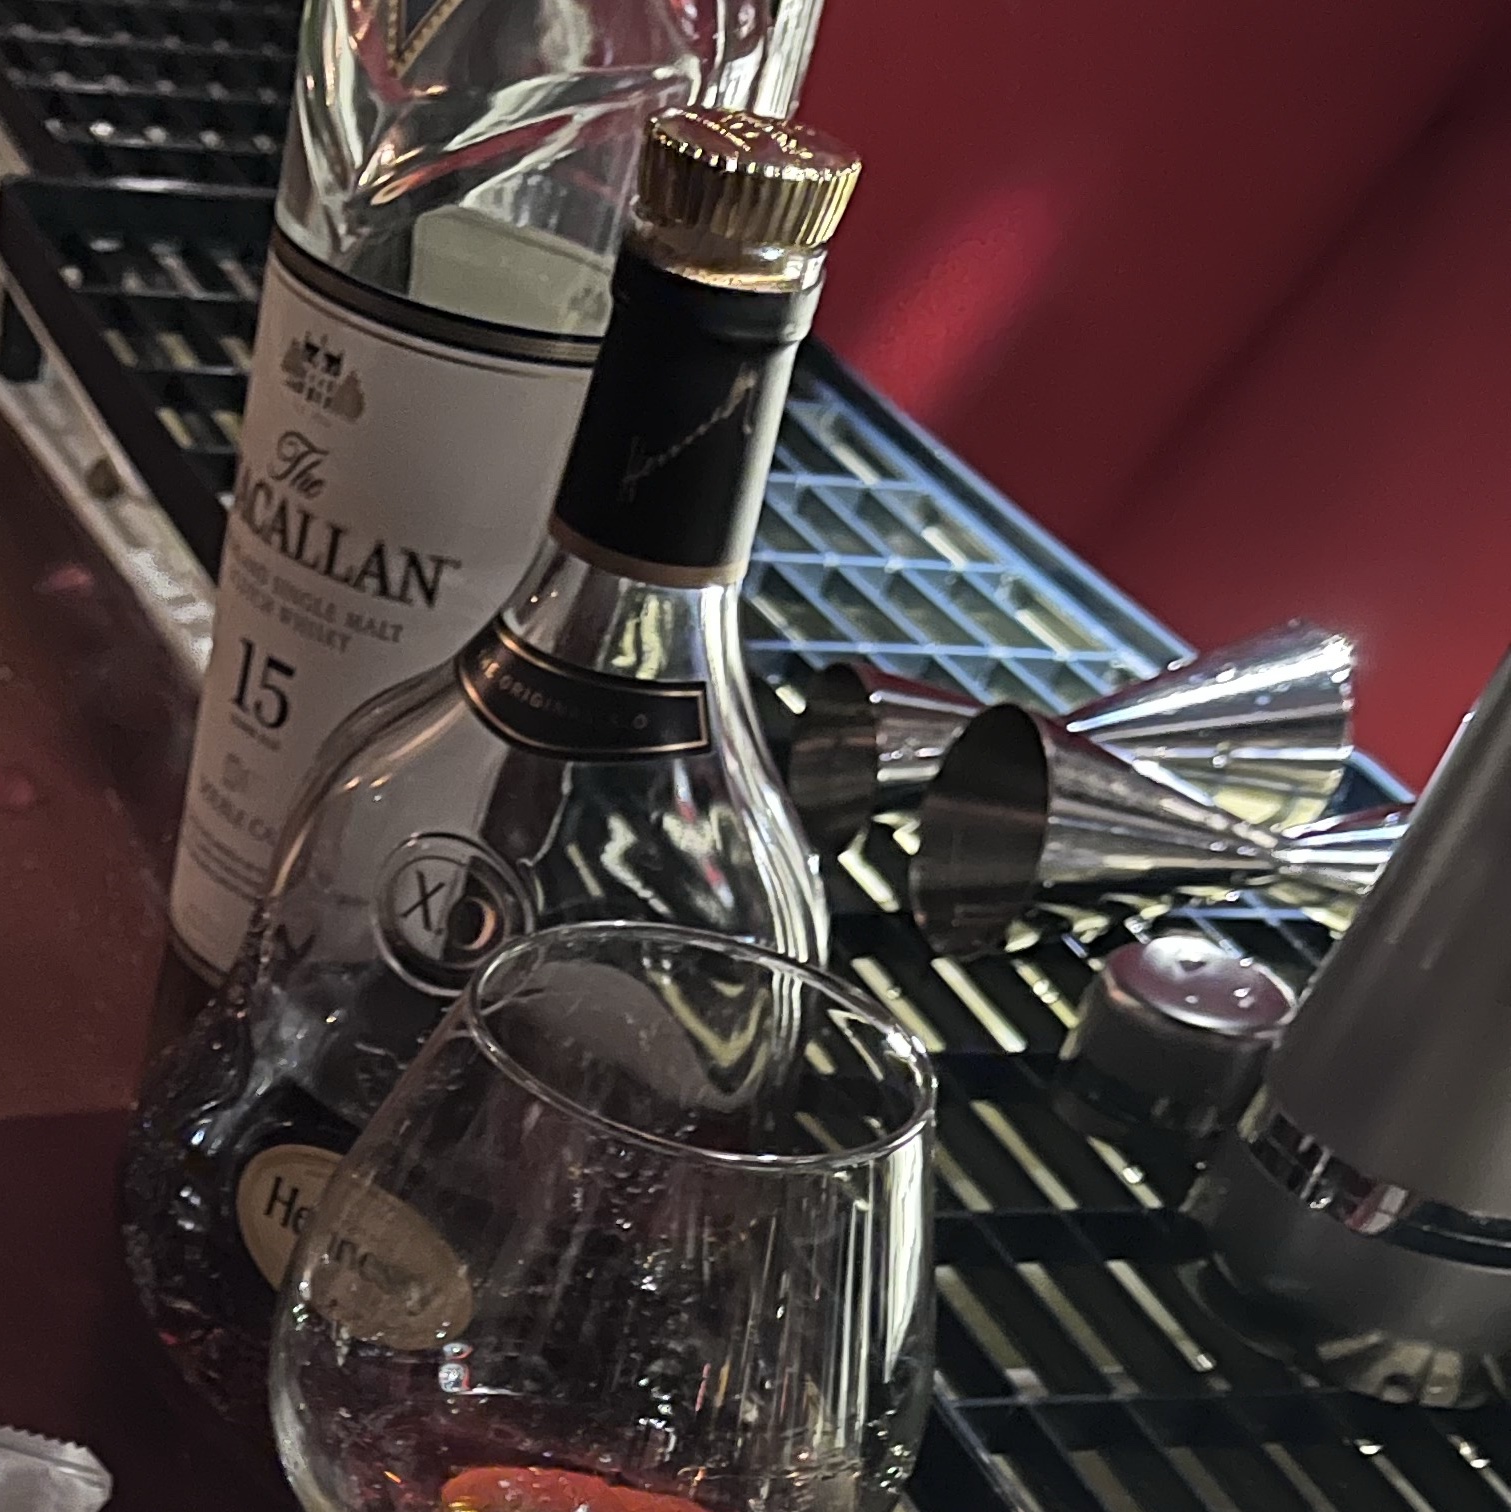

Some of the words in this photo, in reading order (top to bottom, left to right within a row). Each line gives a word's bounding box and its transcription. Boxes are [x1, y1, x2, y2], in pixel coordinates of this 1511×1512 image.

[267, 431, 331, 499] The
[240, 468, 448, 610] CALLAN
[231, 636, 296, 729] 15
